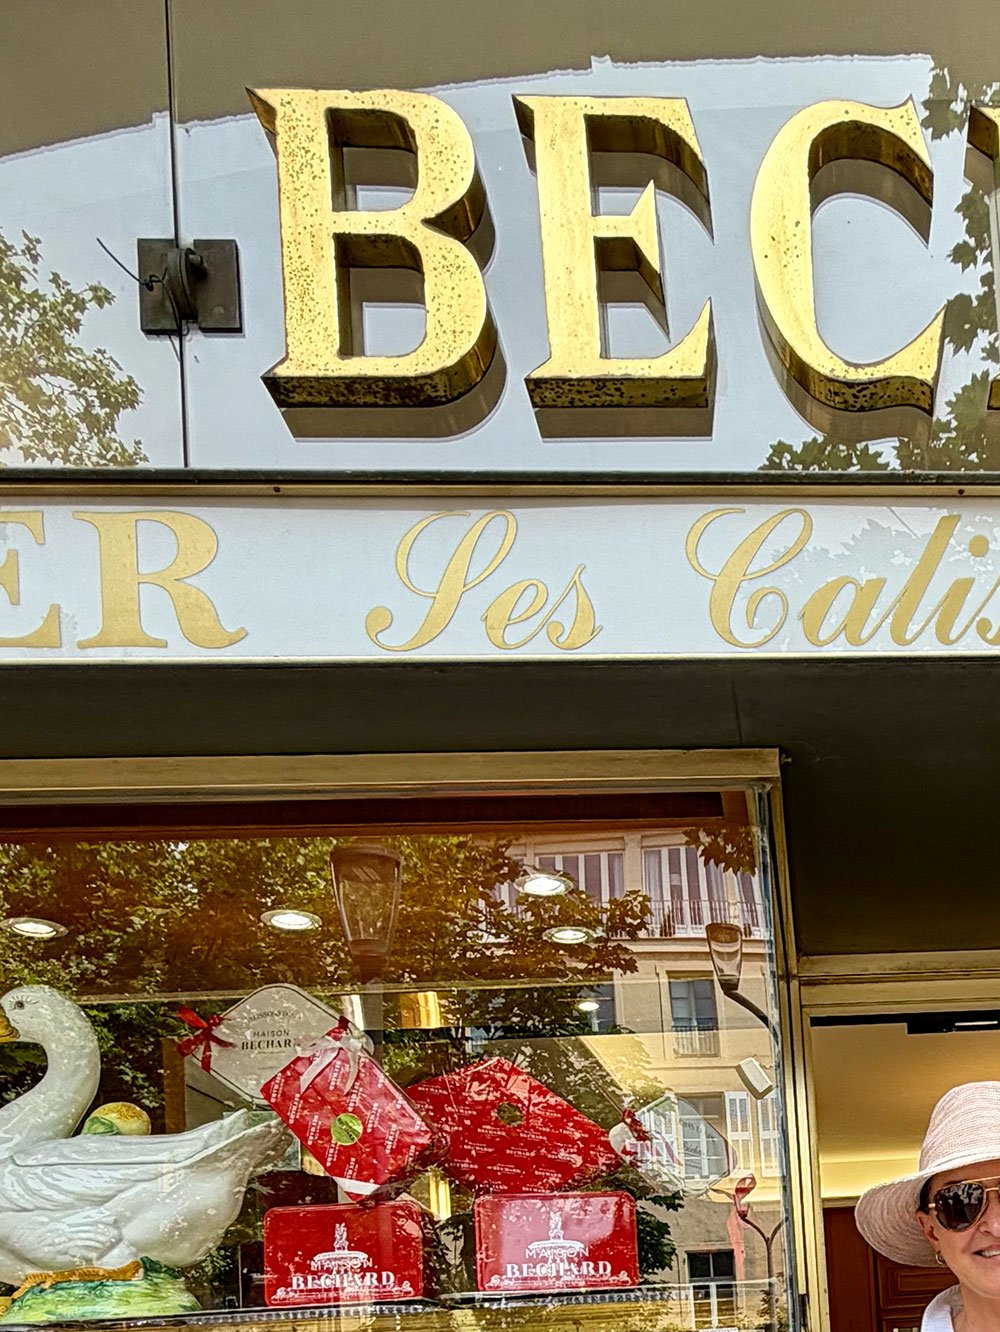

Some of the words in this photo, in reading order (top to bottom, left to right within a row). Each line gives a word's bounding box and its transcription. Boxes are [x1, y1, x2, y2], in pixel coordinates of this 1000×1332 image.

[365, 507, 603, 651] Les
[253, 1029, 290, 1038] MAISON
[241, 1038, 297, 1051] BECHAR
[506, 1260, 612, 1278] BECHARD
